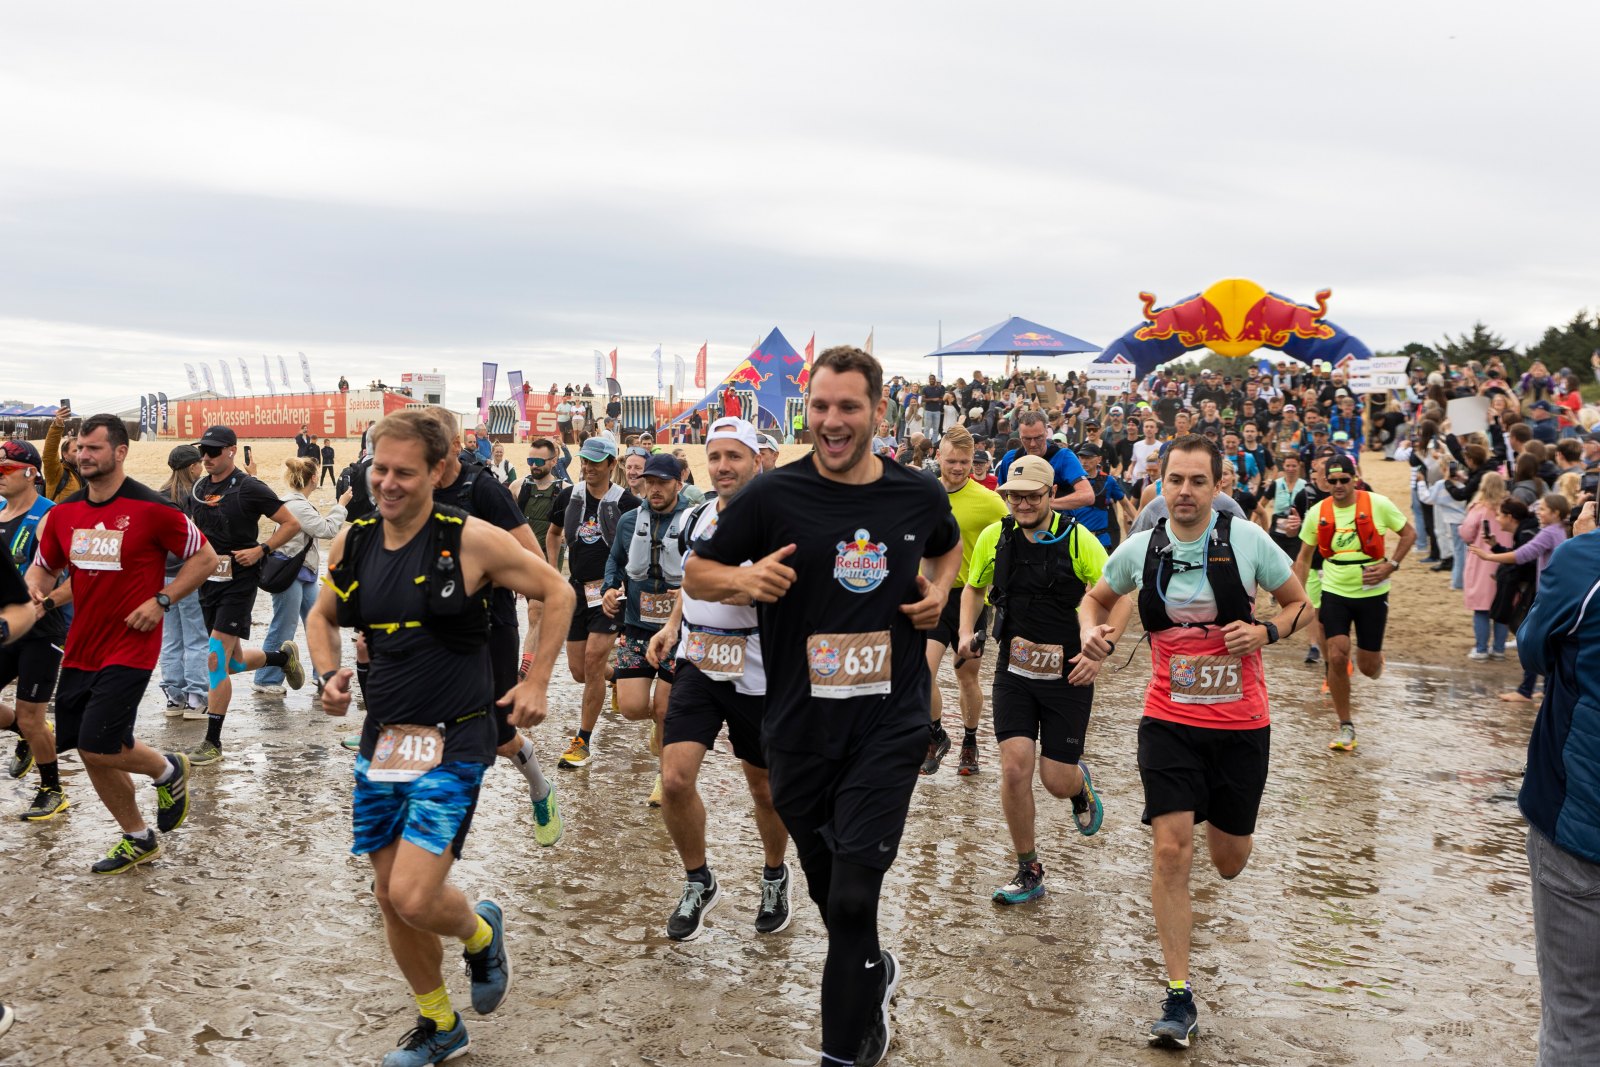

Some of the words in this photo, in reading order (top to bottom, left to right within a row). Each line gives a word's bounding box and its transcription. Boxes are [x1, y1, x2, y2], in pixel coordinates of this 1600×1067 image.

[202, 403, 311, 428] Sparkassen-BeachArena
[349, 398, 380, 410] Sparkasse
[91, 537, 119, 556] 268
[836, 556, 860, 569] Red
[862, 558, 887, 570] Bull
[707, 643, 742, 666] 480
[844, 644, 888, 675] 637
[1030, 650, 1060, 669] 278
[1200, 664, 1238, 688] 575
[397, 735, 436, 762] 413
